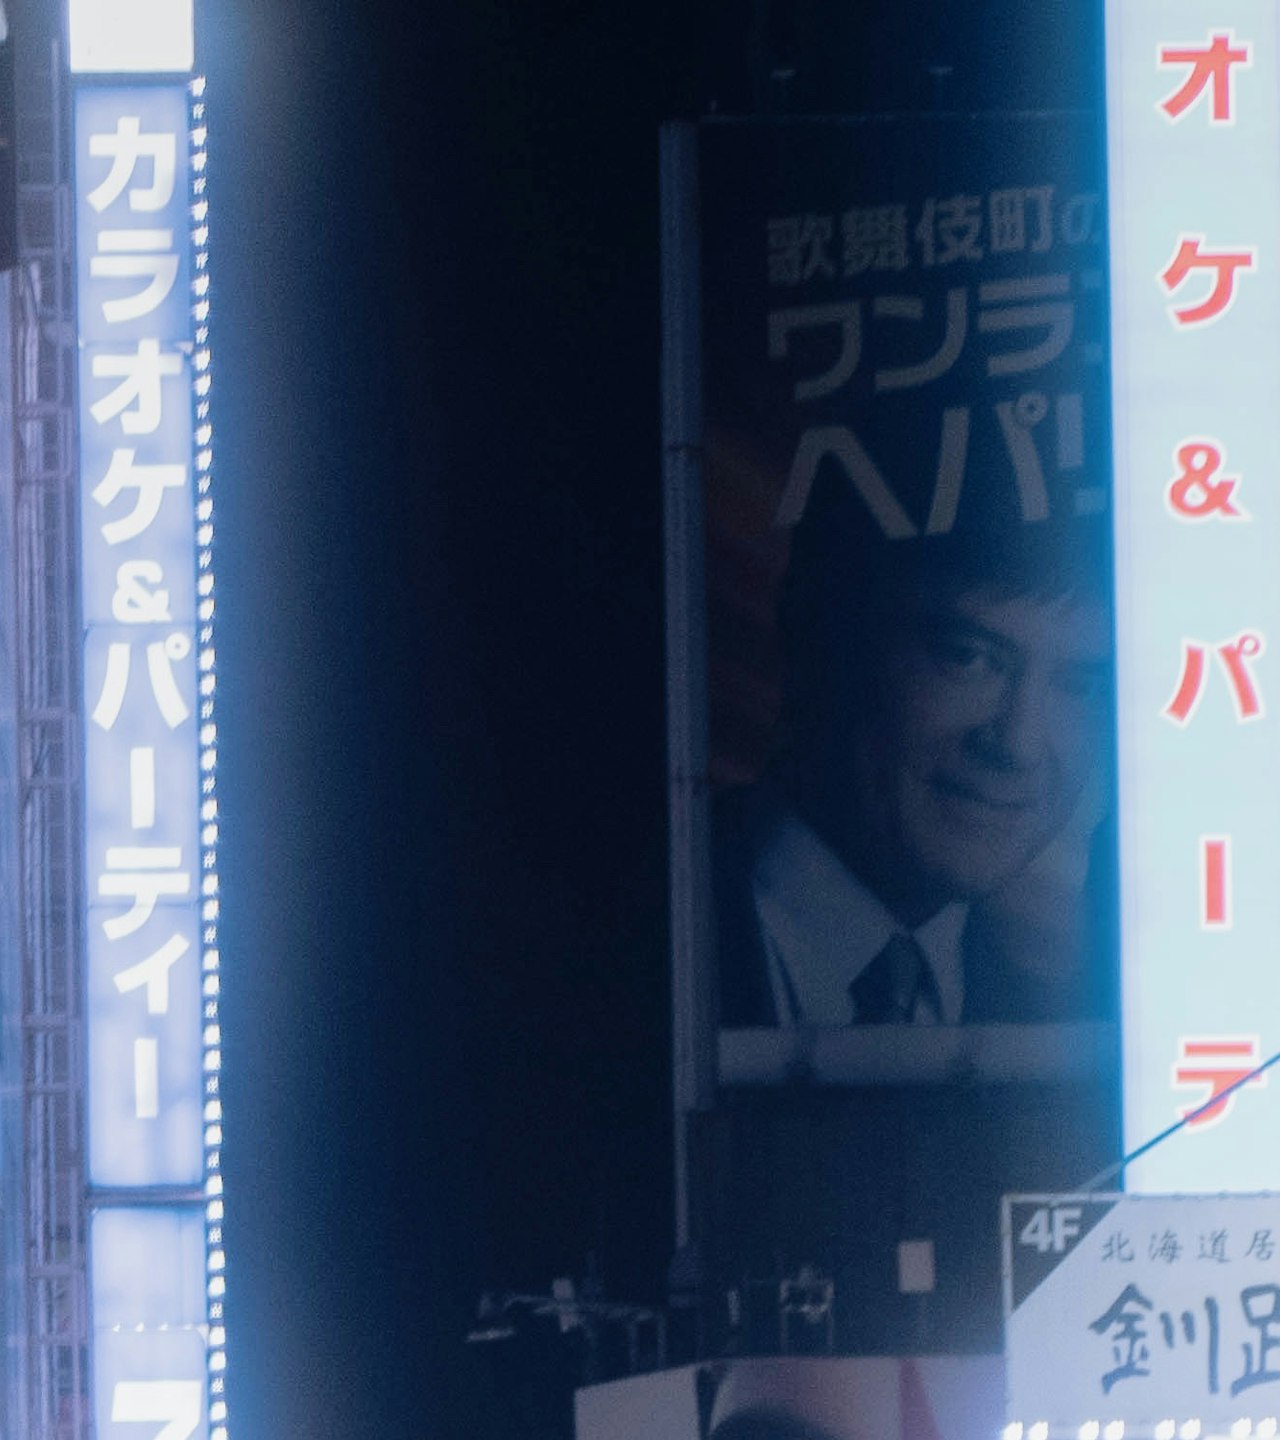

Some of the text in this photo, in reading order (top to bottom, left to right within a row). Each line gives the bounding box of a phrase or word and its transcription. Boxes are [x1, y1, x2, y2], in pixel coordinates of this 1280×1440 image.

[768, 273, 1104, 404] ワンラ
[86, 115, 191, 1119] カラオケ&パーティー
[1022, 1207, 1082, 1254] 4F
